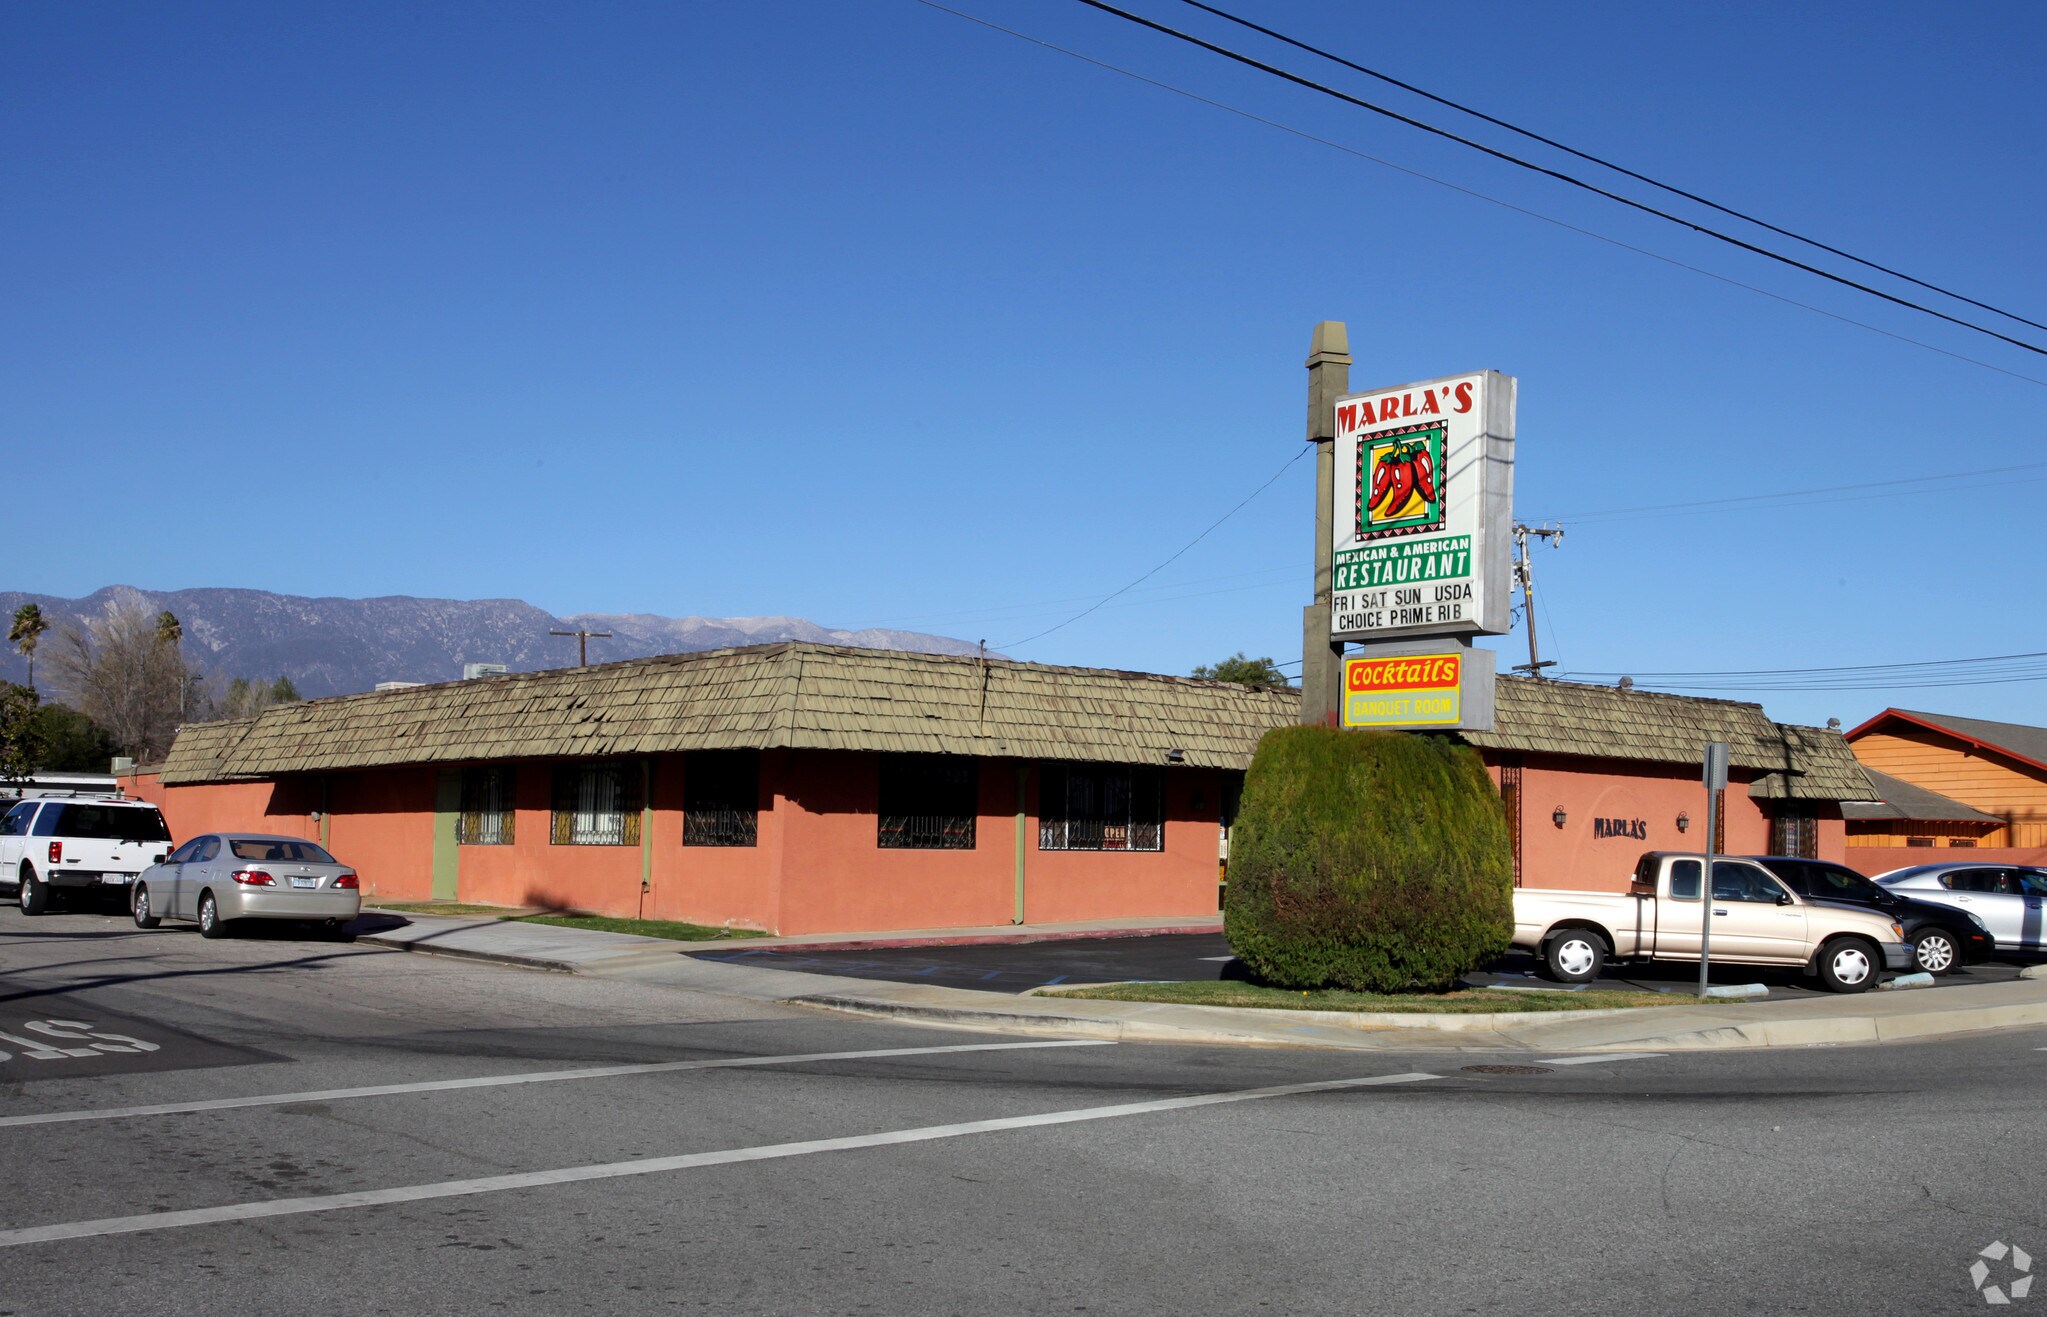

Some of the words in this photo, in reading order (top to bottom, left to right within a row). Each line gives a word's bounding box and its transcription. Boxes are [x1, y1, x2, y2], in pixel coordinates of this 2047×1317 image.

[1337, 382, 1473, 438] MARLA'S
[1336, 549, 1387, 565] MEXICAN
[1390, 547, 1399, 558] &
[1403, 538, 1469, 555] AMERICAN
[1336, 552, 1468, 588] RESTAURANT
[1333, 595, 1355, 612] FRI
[1361, 592, 1387, 608] SAT
[1394, 588, 1421, 605] SUN
[1434, 583, 1472, 602] USDA
[1339, 611, 1382, 630] CHOICE
[1390, 606, 1432, 625] PRIME
[1438, 604, 1462, 621] RIB
[1353, 699, 1410, 717] BANQUET
[1414, 697, 1452, 713] ROOM
[1104, 827, 1126, 838] OPEN
[1594, 817, 1647, 840] MARLA'S
